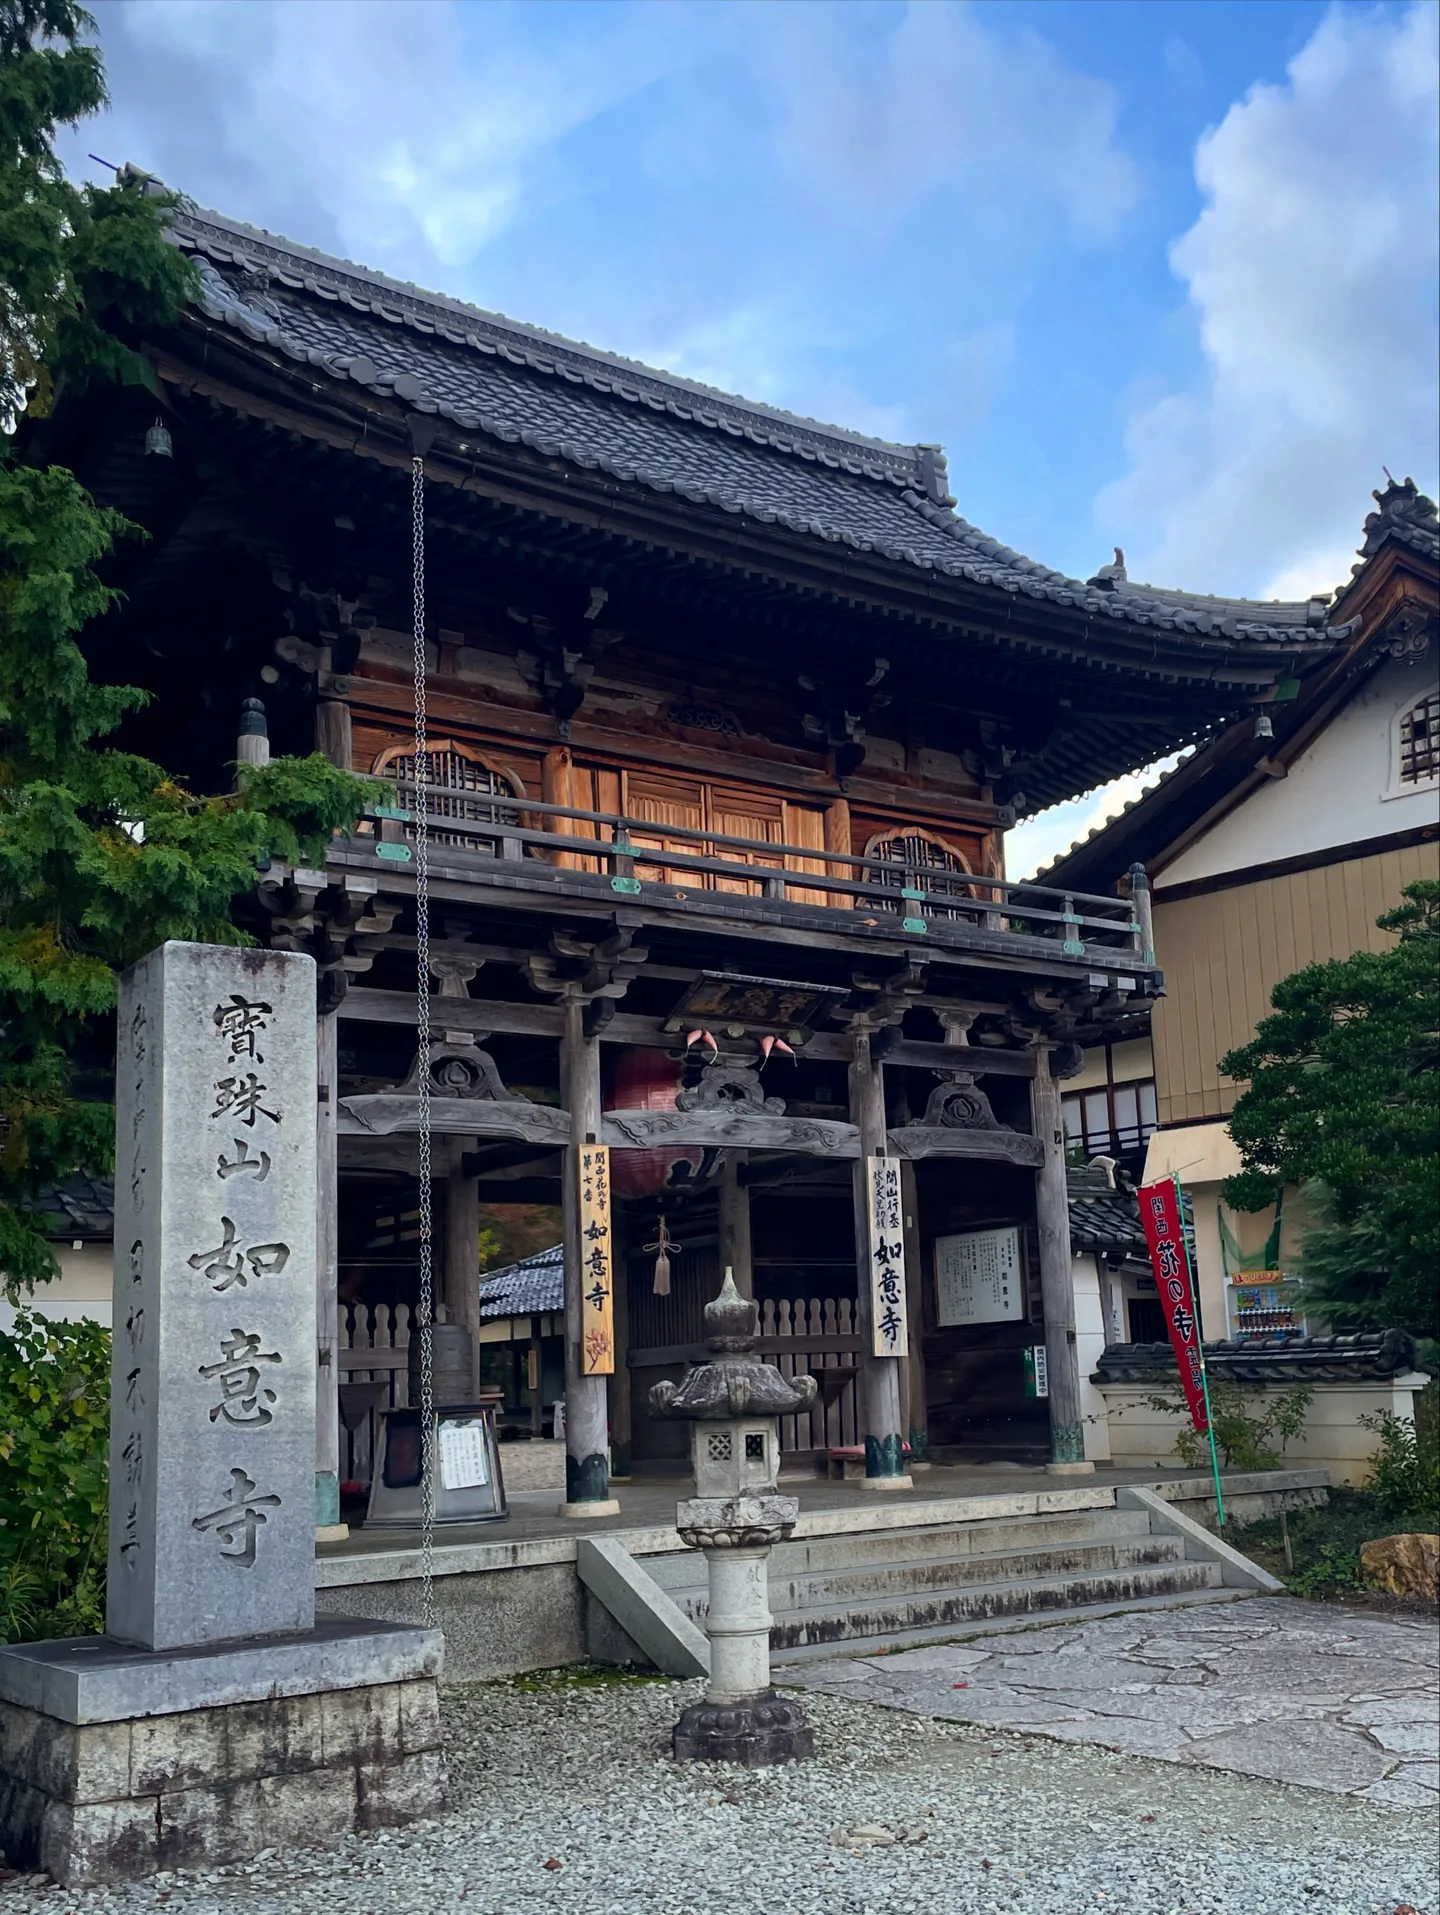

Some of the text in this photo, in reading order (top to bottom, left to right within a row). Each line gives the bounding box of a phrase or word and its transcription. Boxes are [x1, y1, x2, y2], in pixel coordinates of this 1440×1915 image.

[583, 1219, 610, 1312] 如意寺
[873, 1235, 903, 1342] 如意寺
